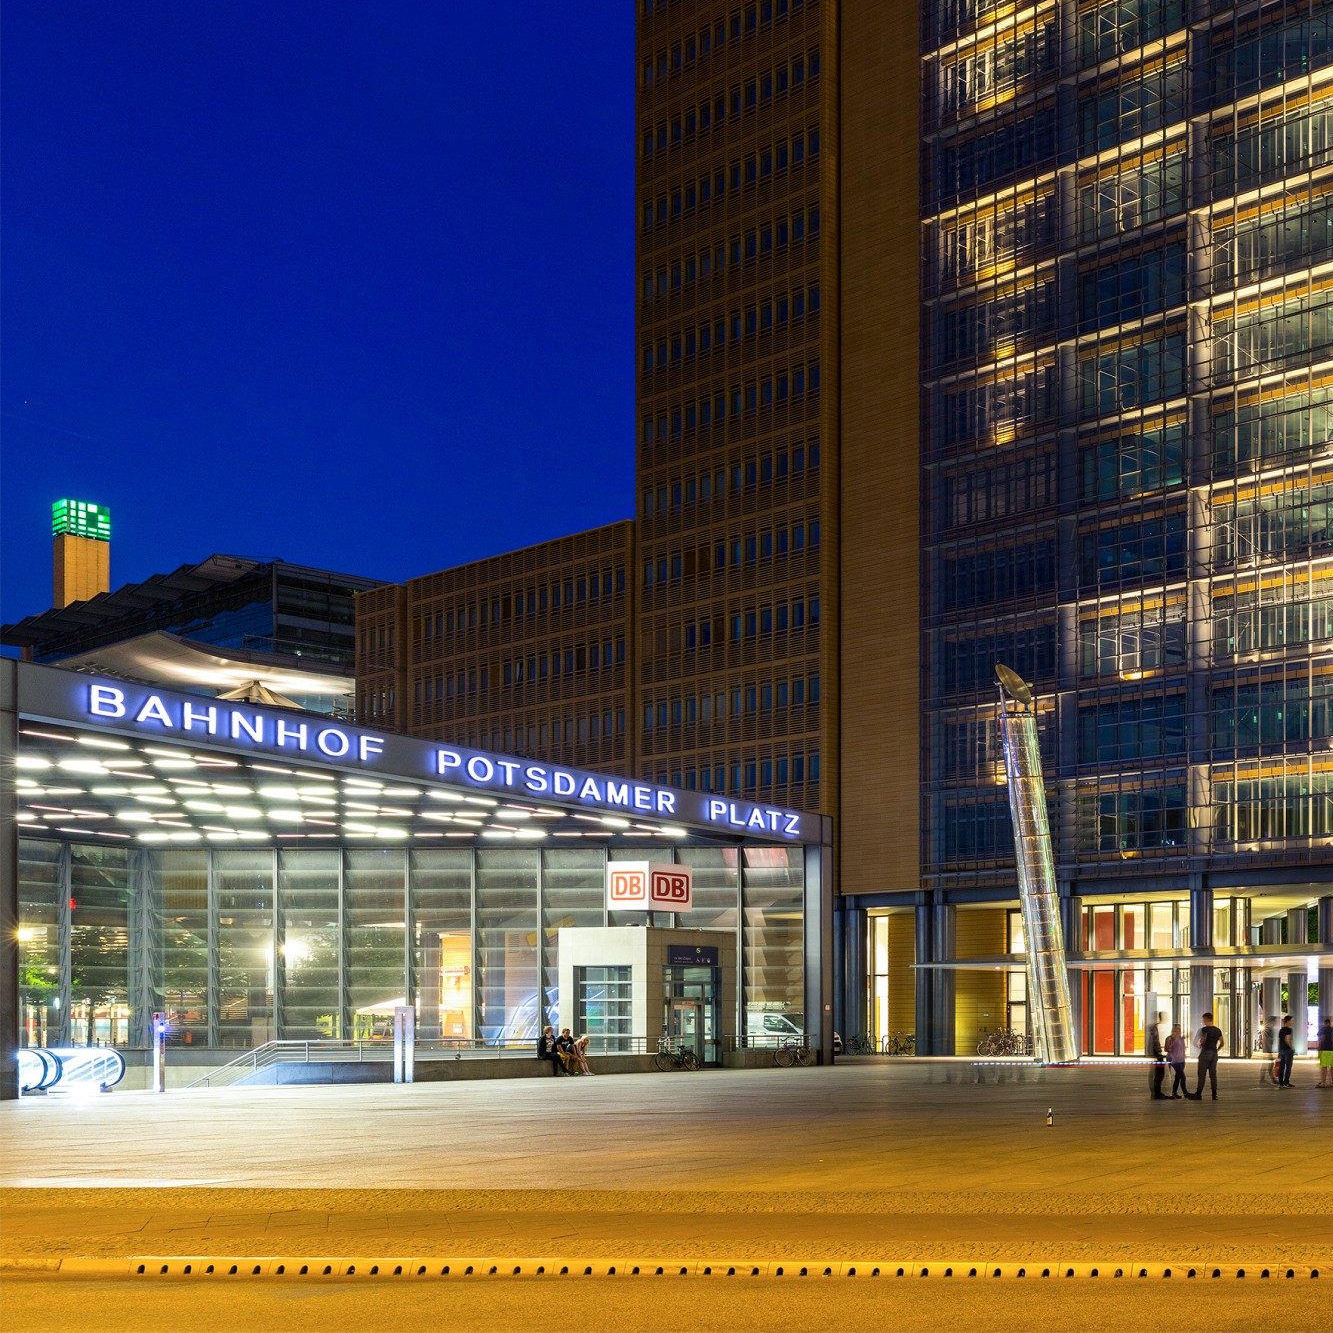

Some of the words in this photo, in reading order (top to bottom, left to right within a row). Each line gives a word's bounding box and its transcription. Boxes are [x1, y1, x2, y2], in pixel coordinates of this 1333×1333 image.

[88, 683, 386, 762] BAHNHOF
[437, 749, 676, 815] POTSDAMER
[709, 799, 801, 835] PLATZ
[615, 875, 642, 896] DB
[656, 876, 685, 898] DB
